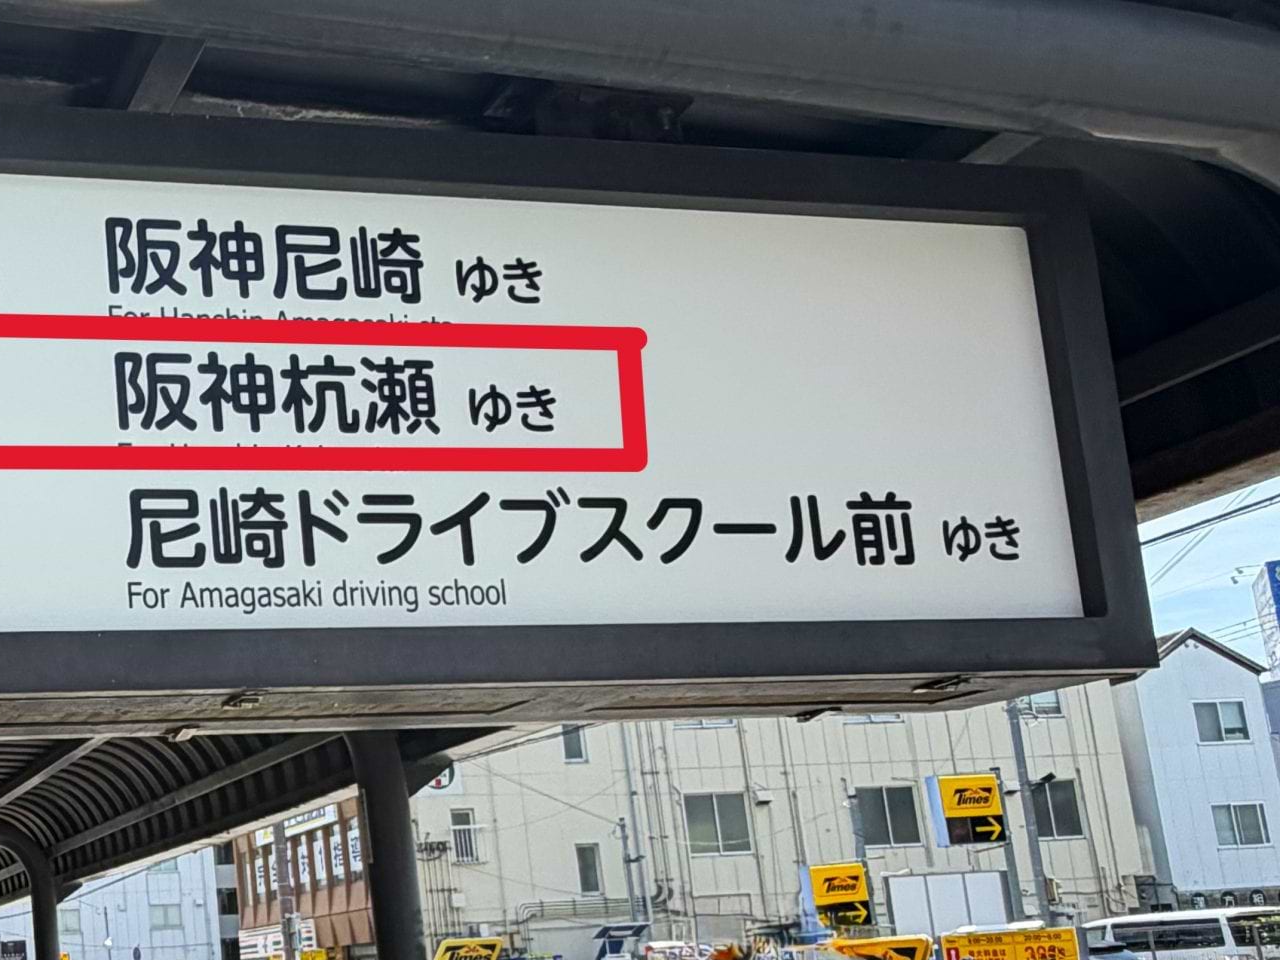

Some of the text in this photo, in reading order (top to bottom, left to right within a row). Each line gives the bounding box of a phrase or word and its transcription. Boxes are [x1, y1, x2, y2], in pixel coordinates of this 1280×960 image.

[104, 216, 543, 304] 阪神尼崎 ゆき
[114, 350, 557, 435] 阪神杭瀬 ゆき
[126, 486, 1021, 569] 尼崎ドライブスクール前 ゆき
[127, 578, 507, 615] For Amagasaki driving school
[953, 787, 993, 807] Times
[823, 875, 860, 894] Times
